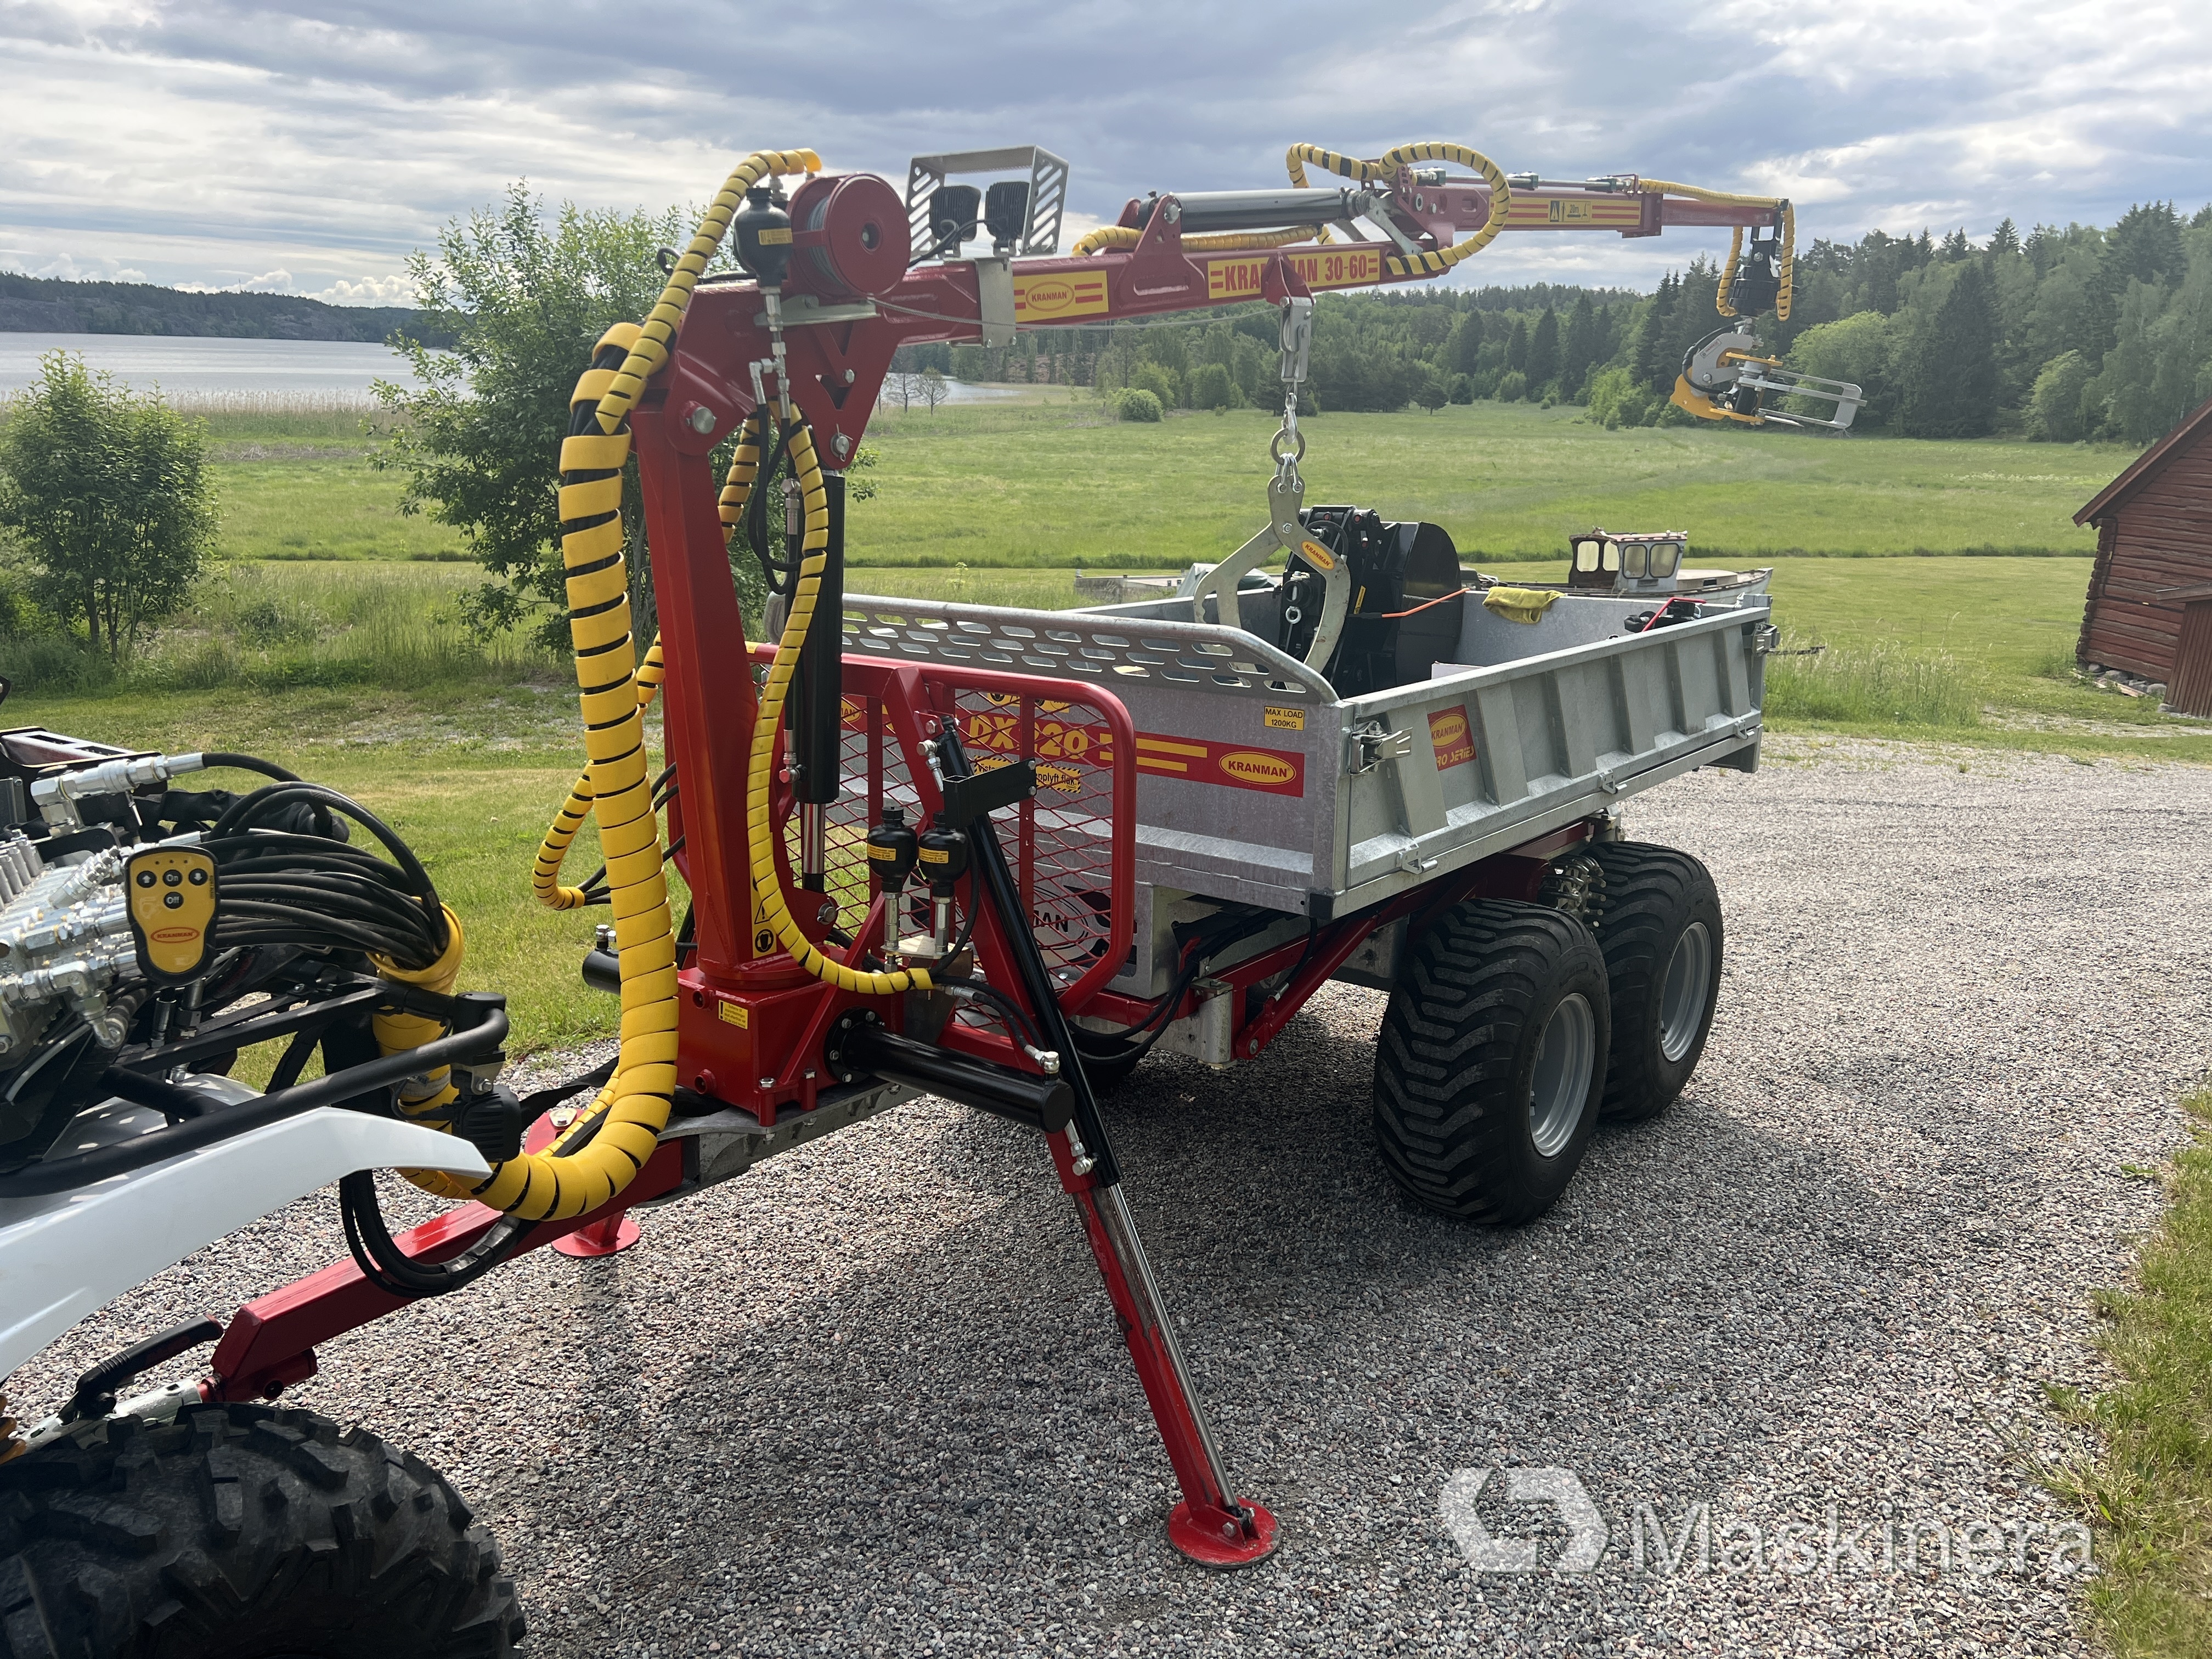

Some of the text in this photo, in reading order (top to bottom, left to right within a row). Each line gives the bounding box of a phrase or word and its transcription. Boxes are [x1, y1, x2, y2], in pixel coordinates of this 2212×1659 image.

[1325, 254, 1367, 281] 30-60
[1031, 291, 1067, 302] KRANMAN
[1305, 544, 1330, 567] KRANMAN
[1265, 708, 1281, 716] MAX
[1271, 719, 1297, 728] 1200KG
[1431, 723, 1463, 740] KRANMAN
[1228, 760, 1288, 778] KRANMAN
[1036, 772, 1059, 784] pplyft
[167, 874, 179, 882] On
[166, 896, 180, 905] Off
